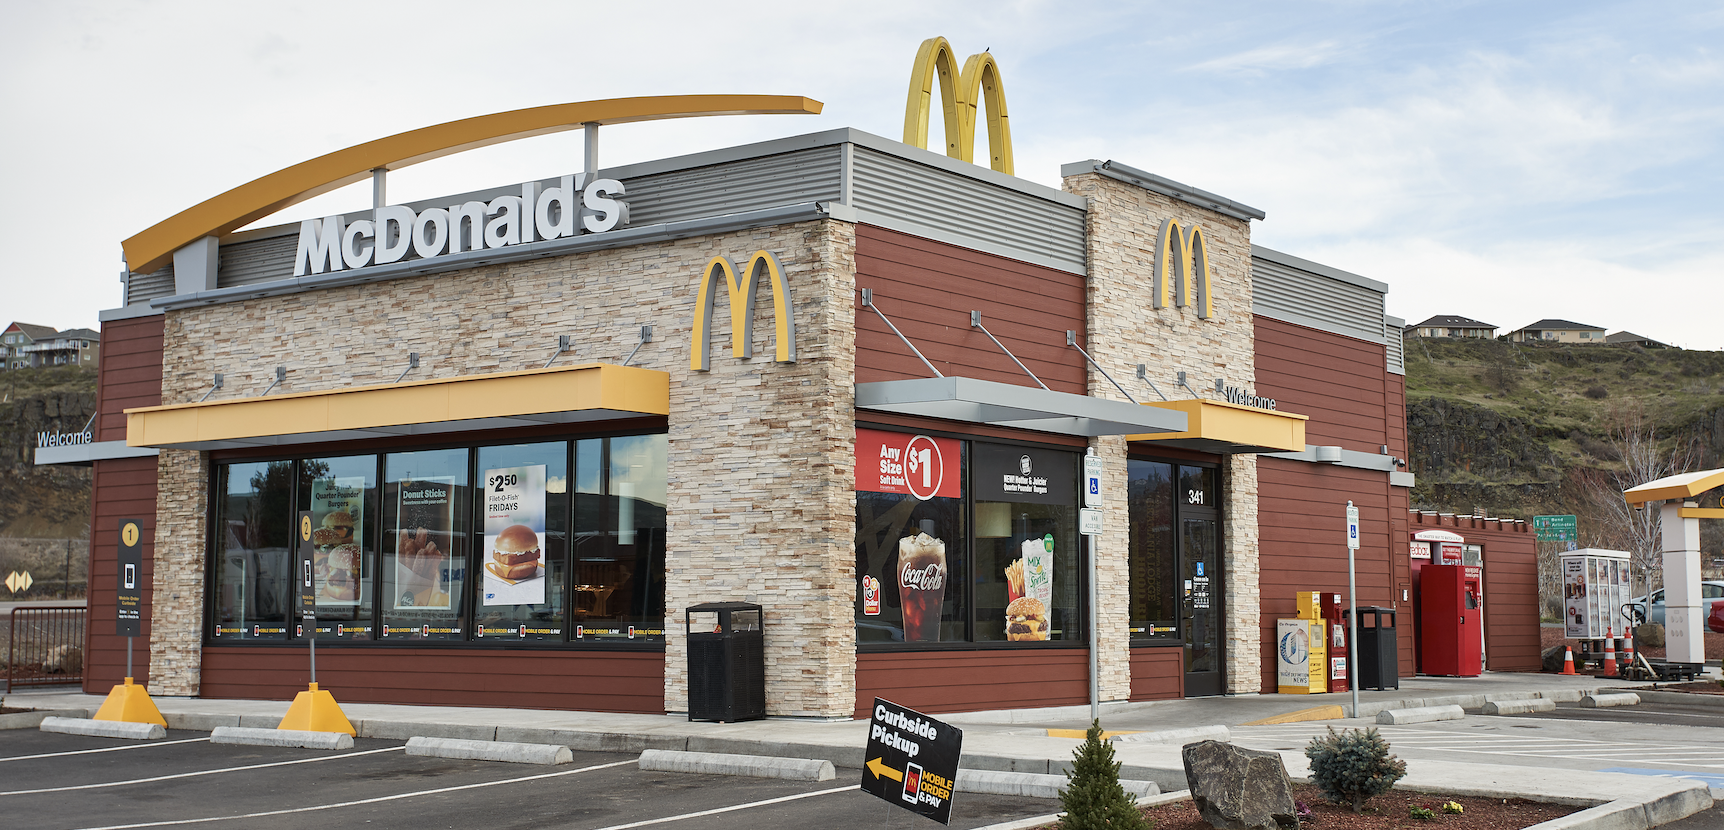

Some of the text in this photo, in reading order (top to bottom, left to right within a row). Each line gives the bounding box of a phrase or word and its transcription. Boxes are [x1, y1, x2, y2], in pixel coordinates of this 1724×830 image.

[294, 173, 630, 277] McDonald's
[1227, 386, 1276, 411] Welcome
[37, 430, 92, 447] Welcome
[880, 444, 900, 462] Any
[880, 459, 902, 475] Size
[908, 447, 931, 488] $1
[1087, 468, 1101, 476] PARKING
[880, 475, 905, 486] Soft Drink
[1004, 475, 1015, 483] NEW!
[316, 492, 336, 500] Quarter
[403, 489, 446, 499] Donut Sticks
[1004, 483, 1047, 494] Quarter Pounder Burgers
[1188, 489, 1203, 504] 341
[489, 494, 518, 502] Filet-O-Fish
[489, 503, 518, 512] FRIDAYS
[304, 522, 308, 535] 2
[901, 562, 943, 591] Coca-Cola
[875, 704, 938, 740] Curbside
[871, 724, 920, 758] Pickup
[922, 770, 953, 790] MOBILE
[920, 781, 950, 800] ORDER
[918, 791, 941, 808] & PAY
